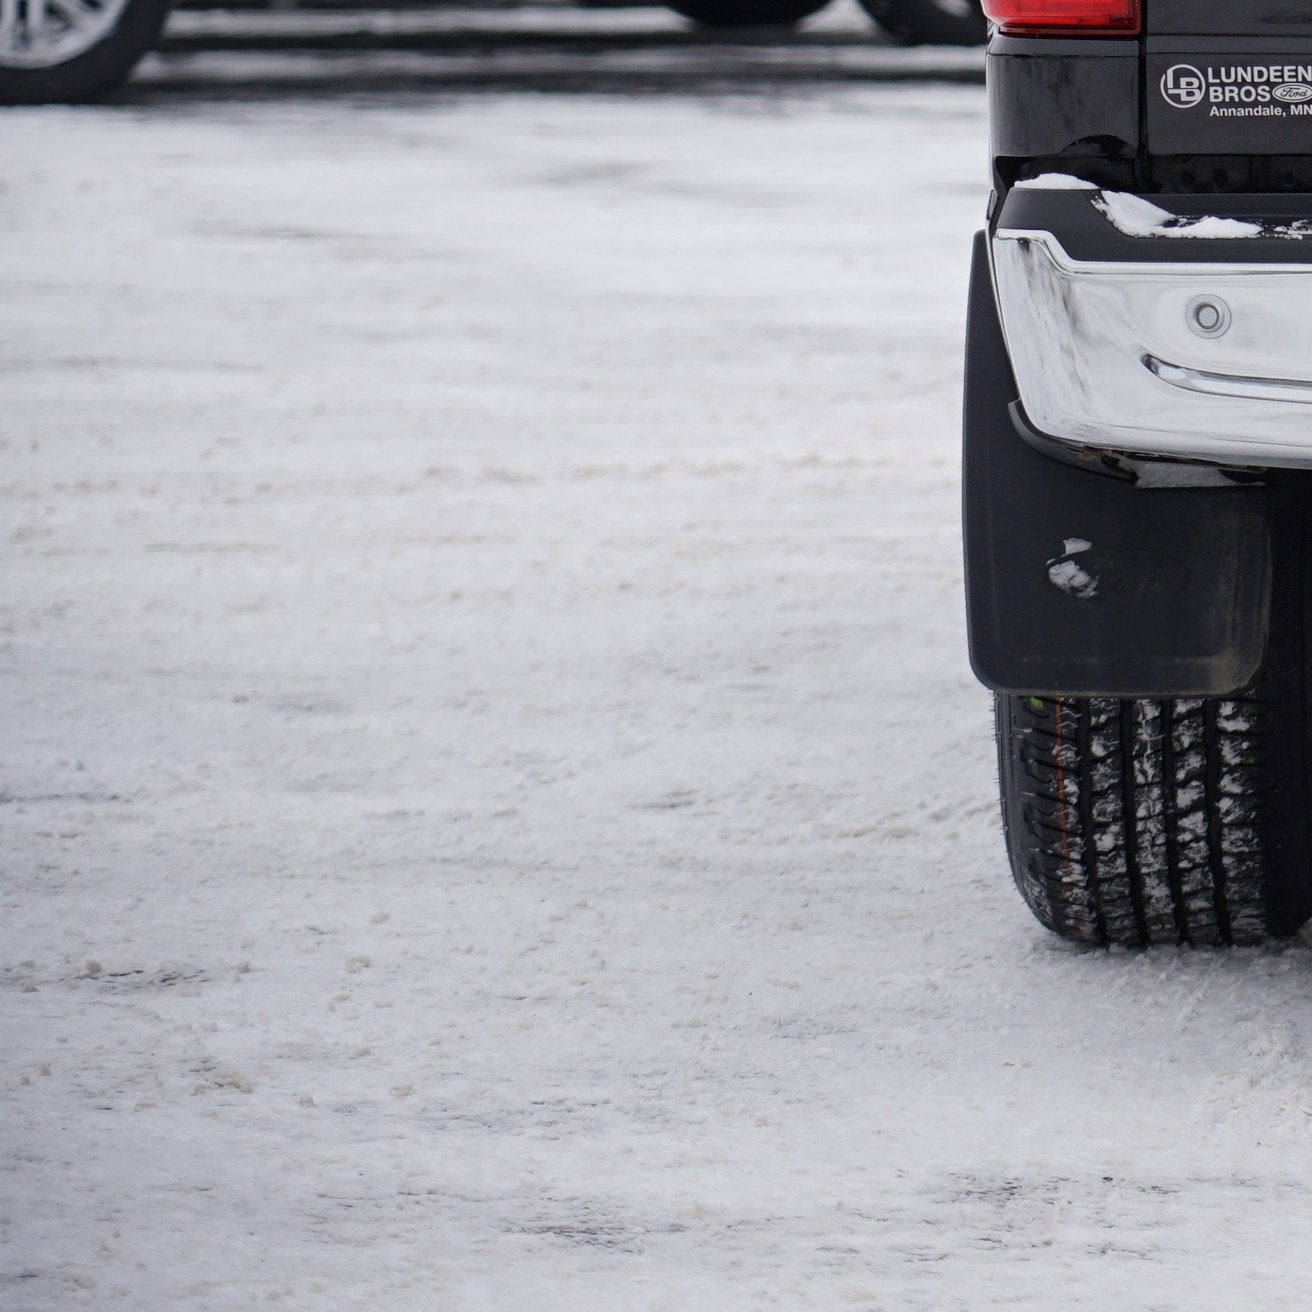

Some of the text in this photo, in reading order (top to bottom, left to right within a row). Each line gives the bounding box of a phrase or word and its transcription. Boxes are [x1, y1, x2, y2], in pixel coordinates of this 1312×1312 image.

[1208, 66, 1312, 83] LUNDEEN
[1209, 86, 1271, 103] BROS
[1209, 105, 1287, 118] Annandale,
